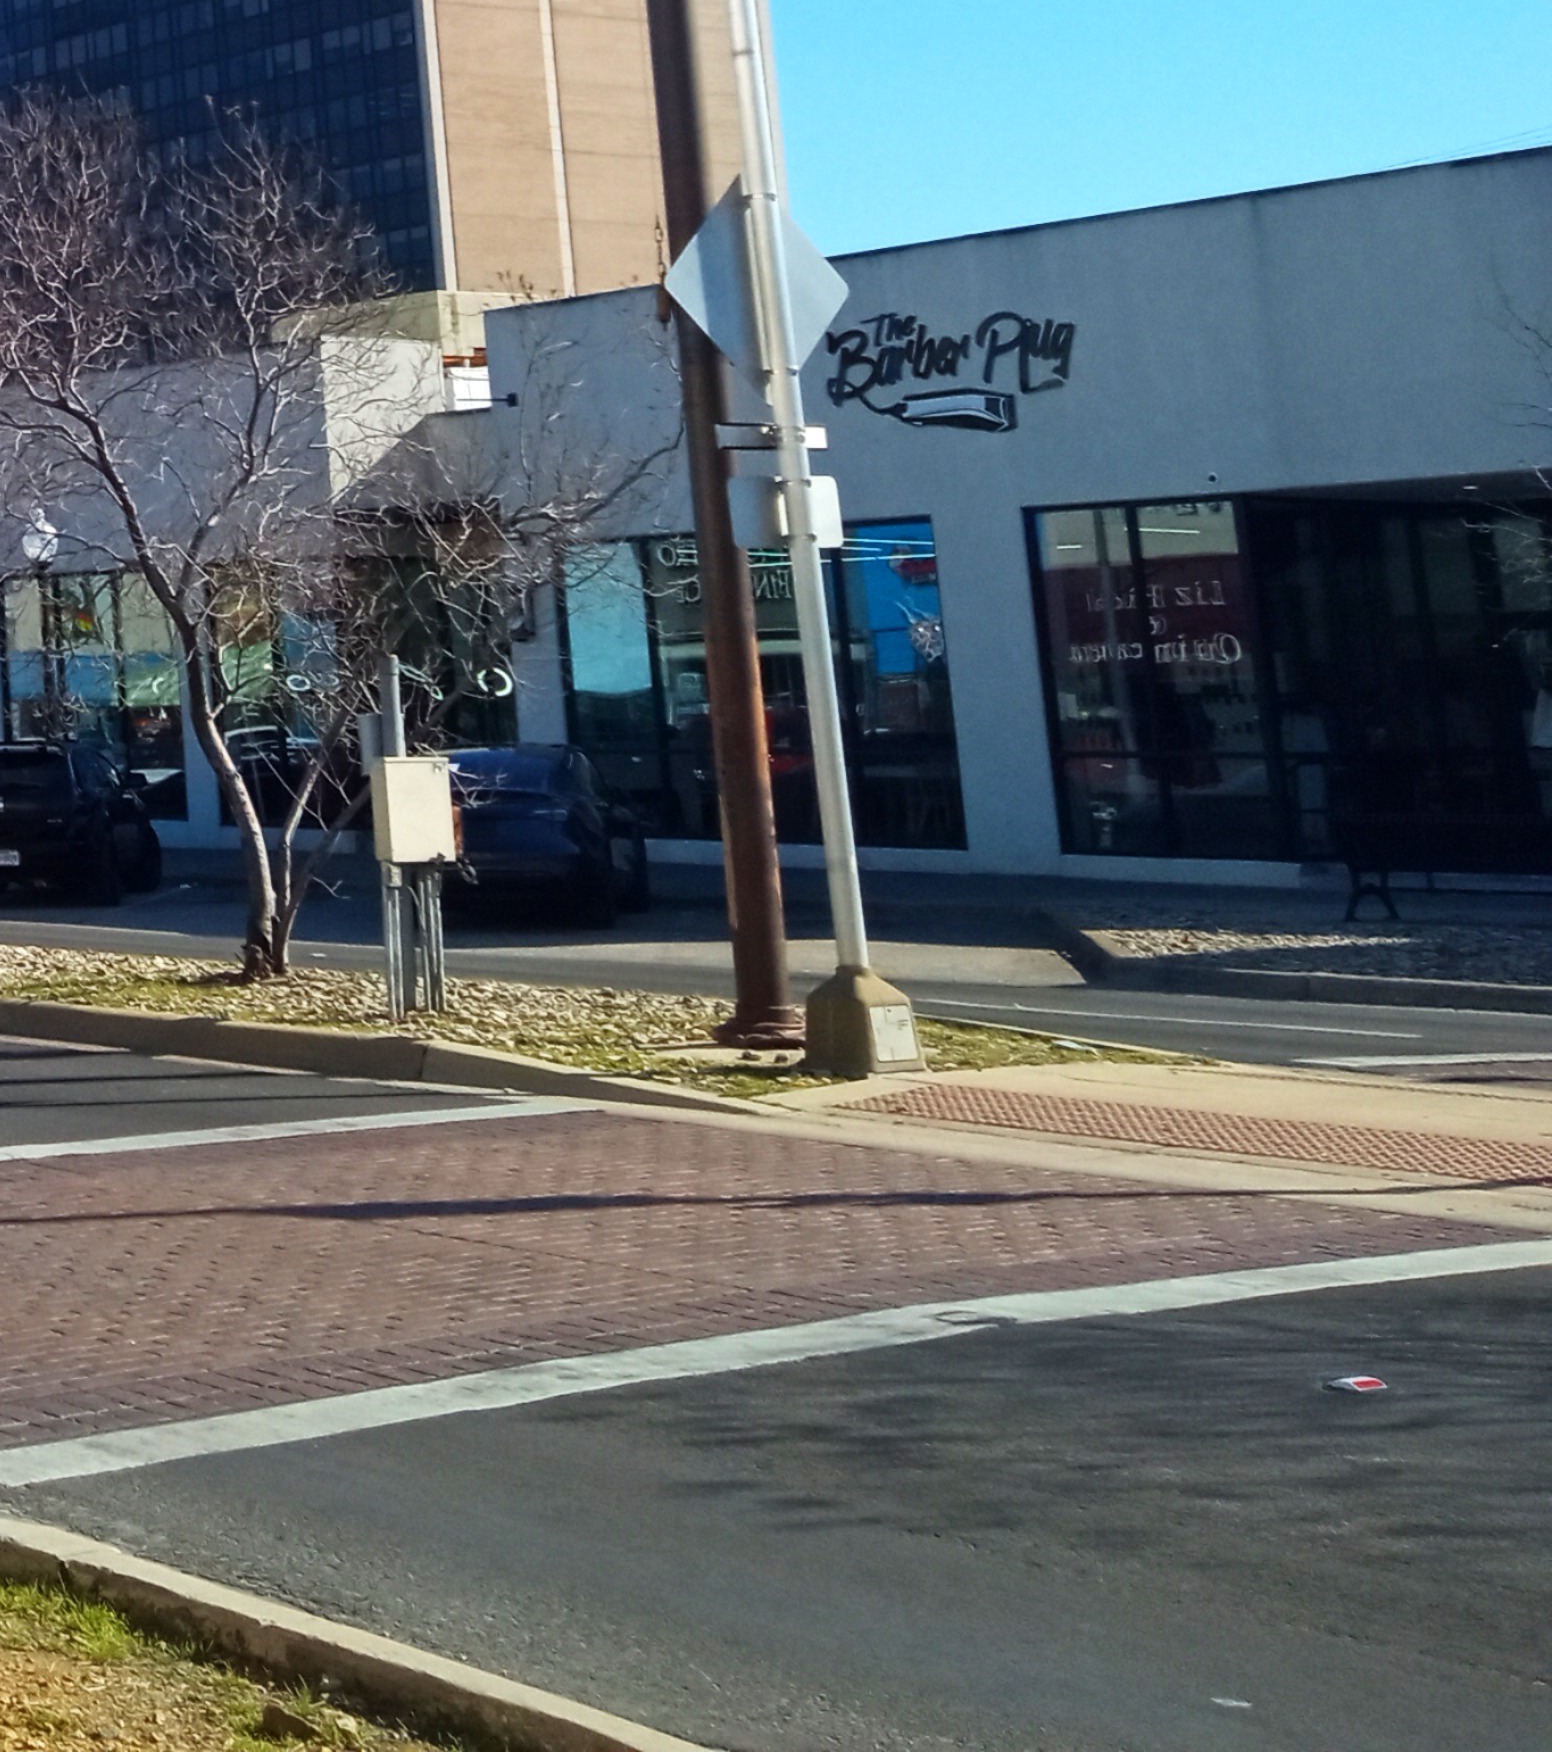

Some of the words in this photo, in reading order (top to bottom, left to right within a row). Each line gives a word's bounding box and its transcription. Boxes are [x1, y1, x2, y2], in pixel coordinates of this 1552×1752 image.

[826, 324, 971, 407] Barber
[975, 311, 1076, 394] Plug
[860, 312, 917, 346] The
